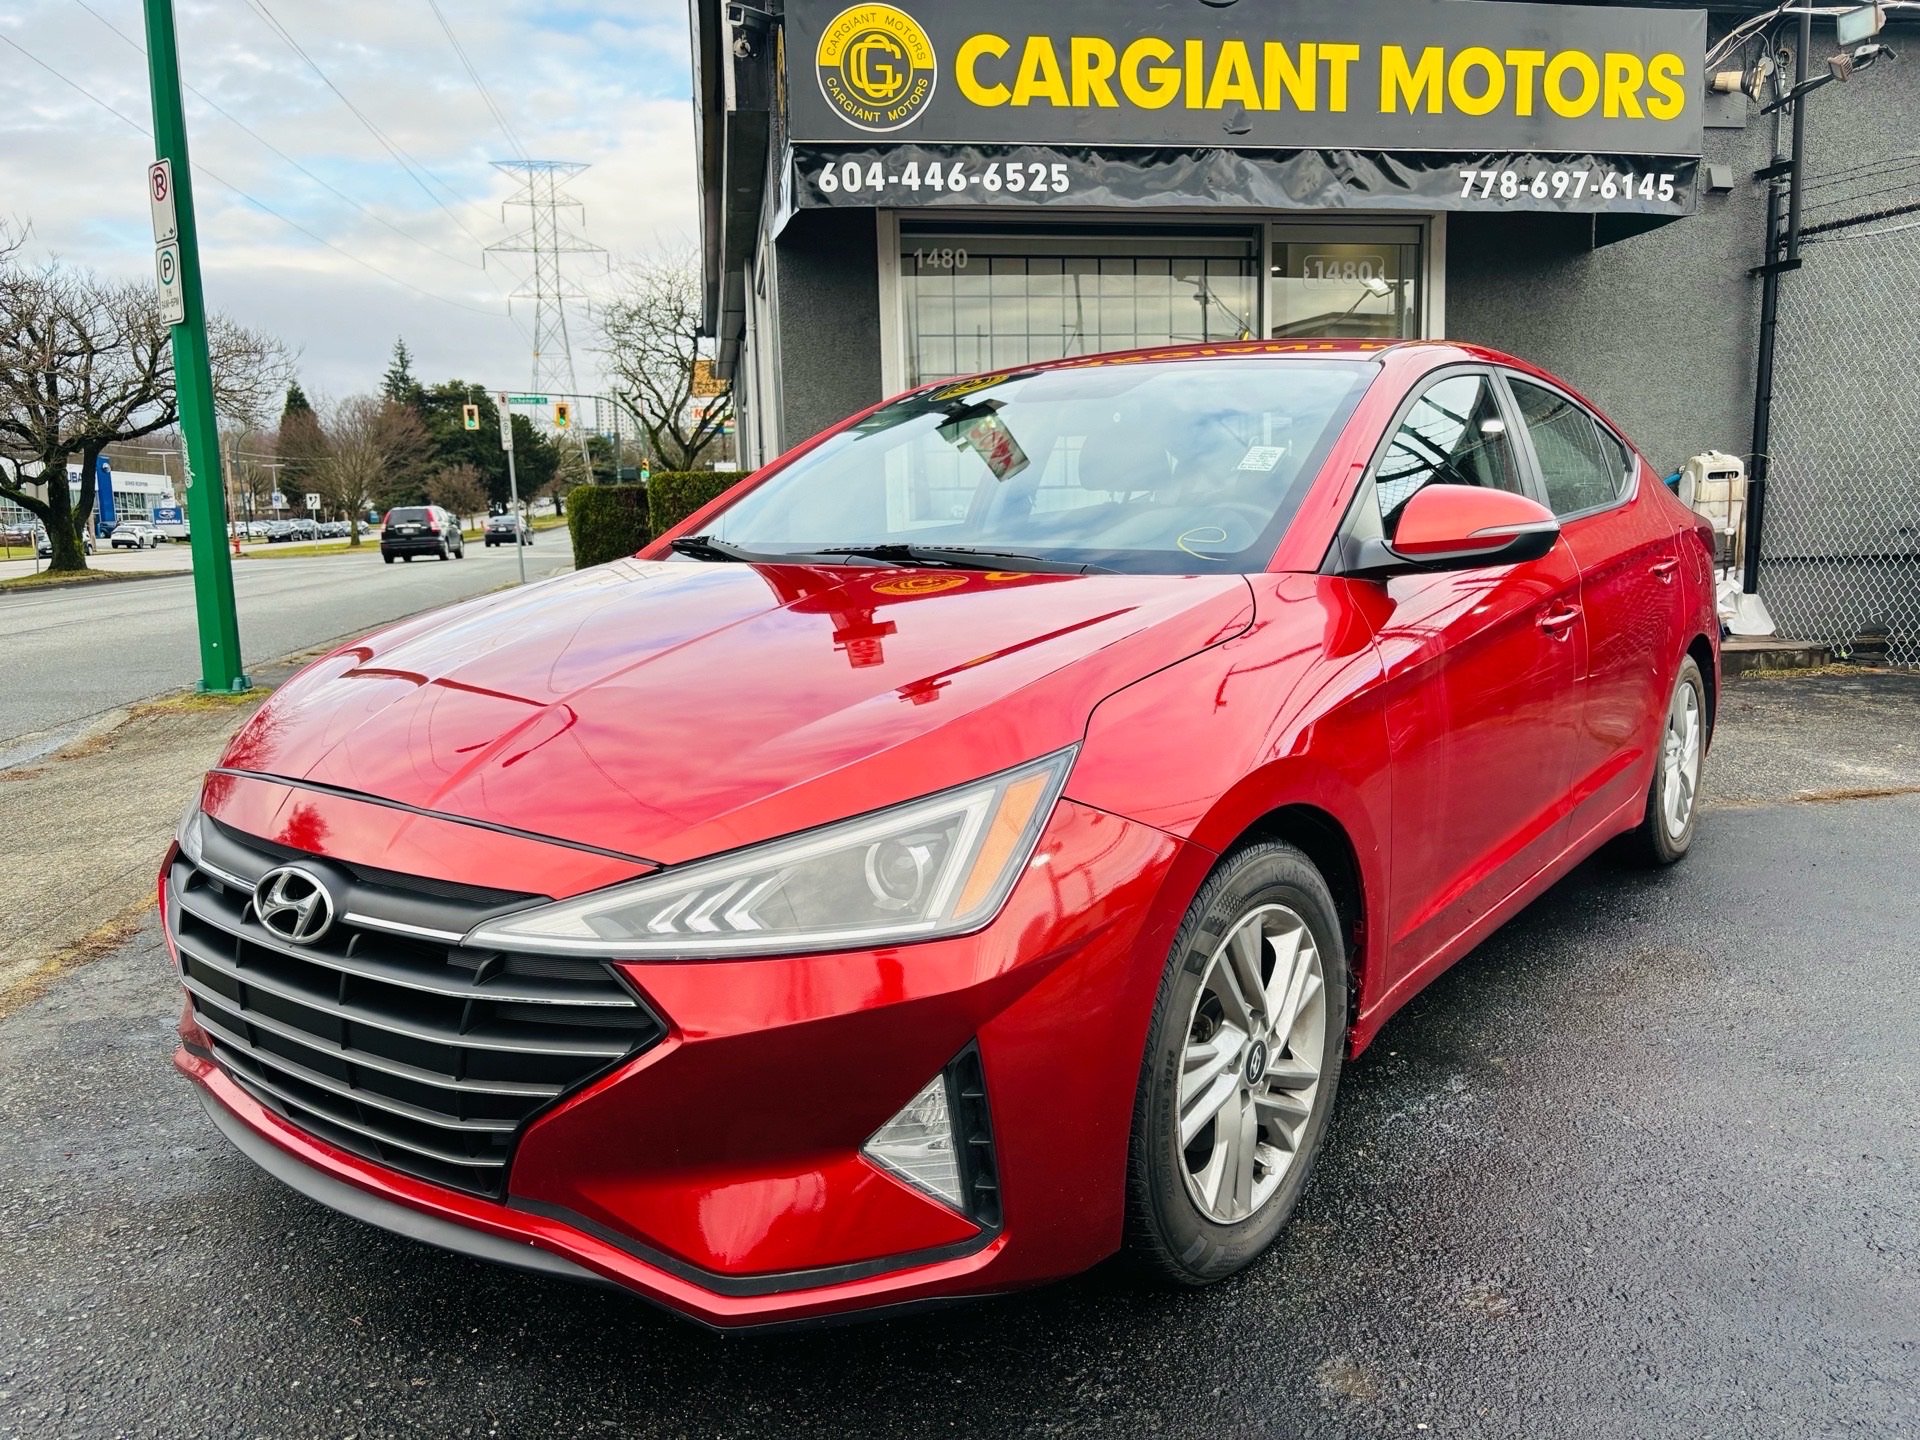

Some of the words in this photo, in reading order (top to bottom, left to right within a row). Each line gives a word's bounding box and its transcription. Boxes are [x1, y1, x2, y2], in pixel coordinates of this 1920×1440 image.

[826, 12, 877, 56] CARGIANT
[885, 15, 926, 61] MOTORS
[955, 33, 1360, 112] CARGIANT
[1380, 45, 1685, 120] MOTORS
[826, 77, 881, 122] CARGIANT
[887, 78, 928, 121] MOTORS
[818, 161, 1070, 193] 604-446-6525
[1459, 170, 1675, 202] 778-697-6145
[913, 248, 968, 269] 1480
[1314, 260, 1373, 284] 1480
